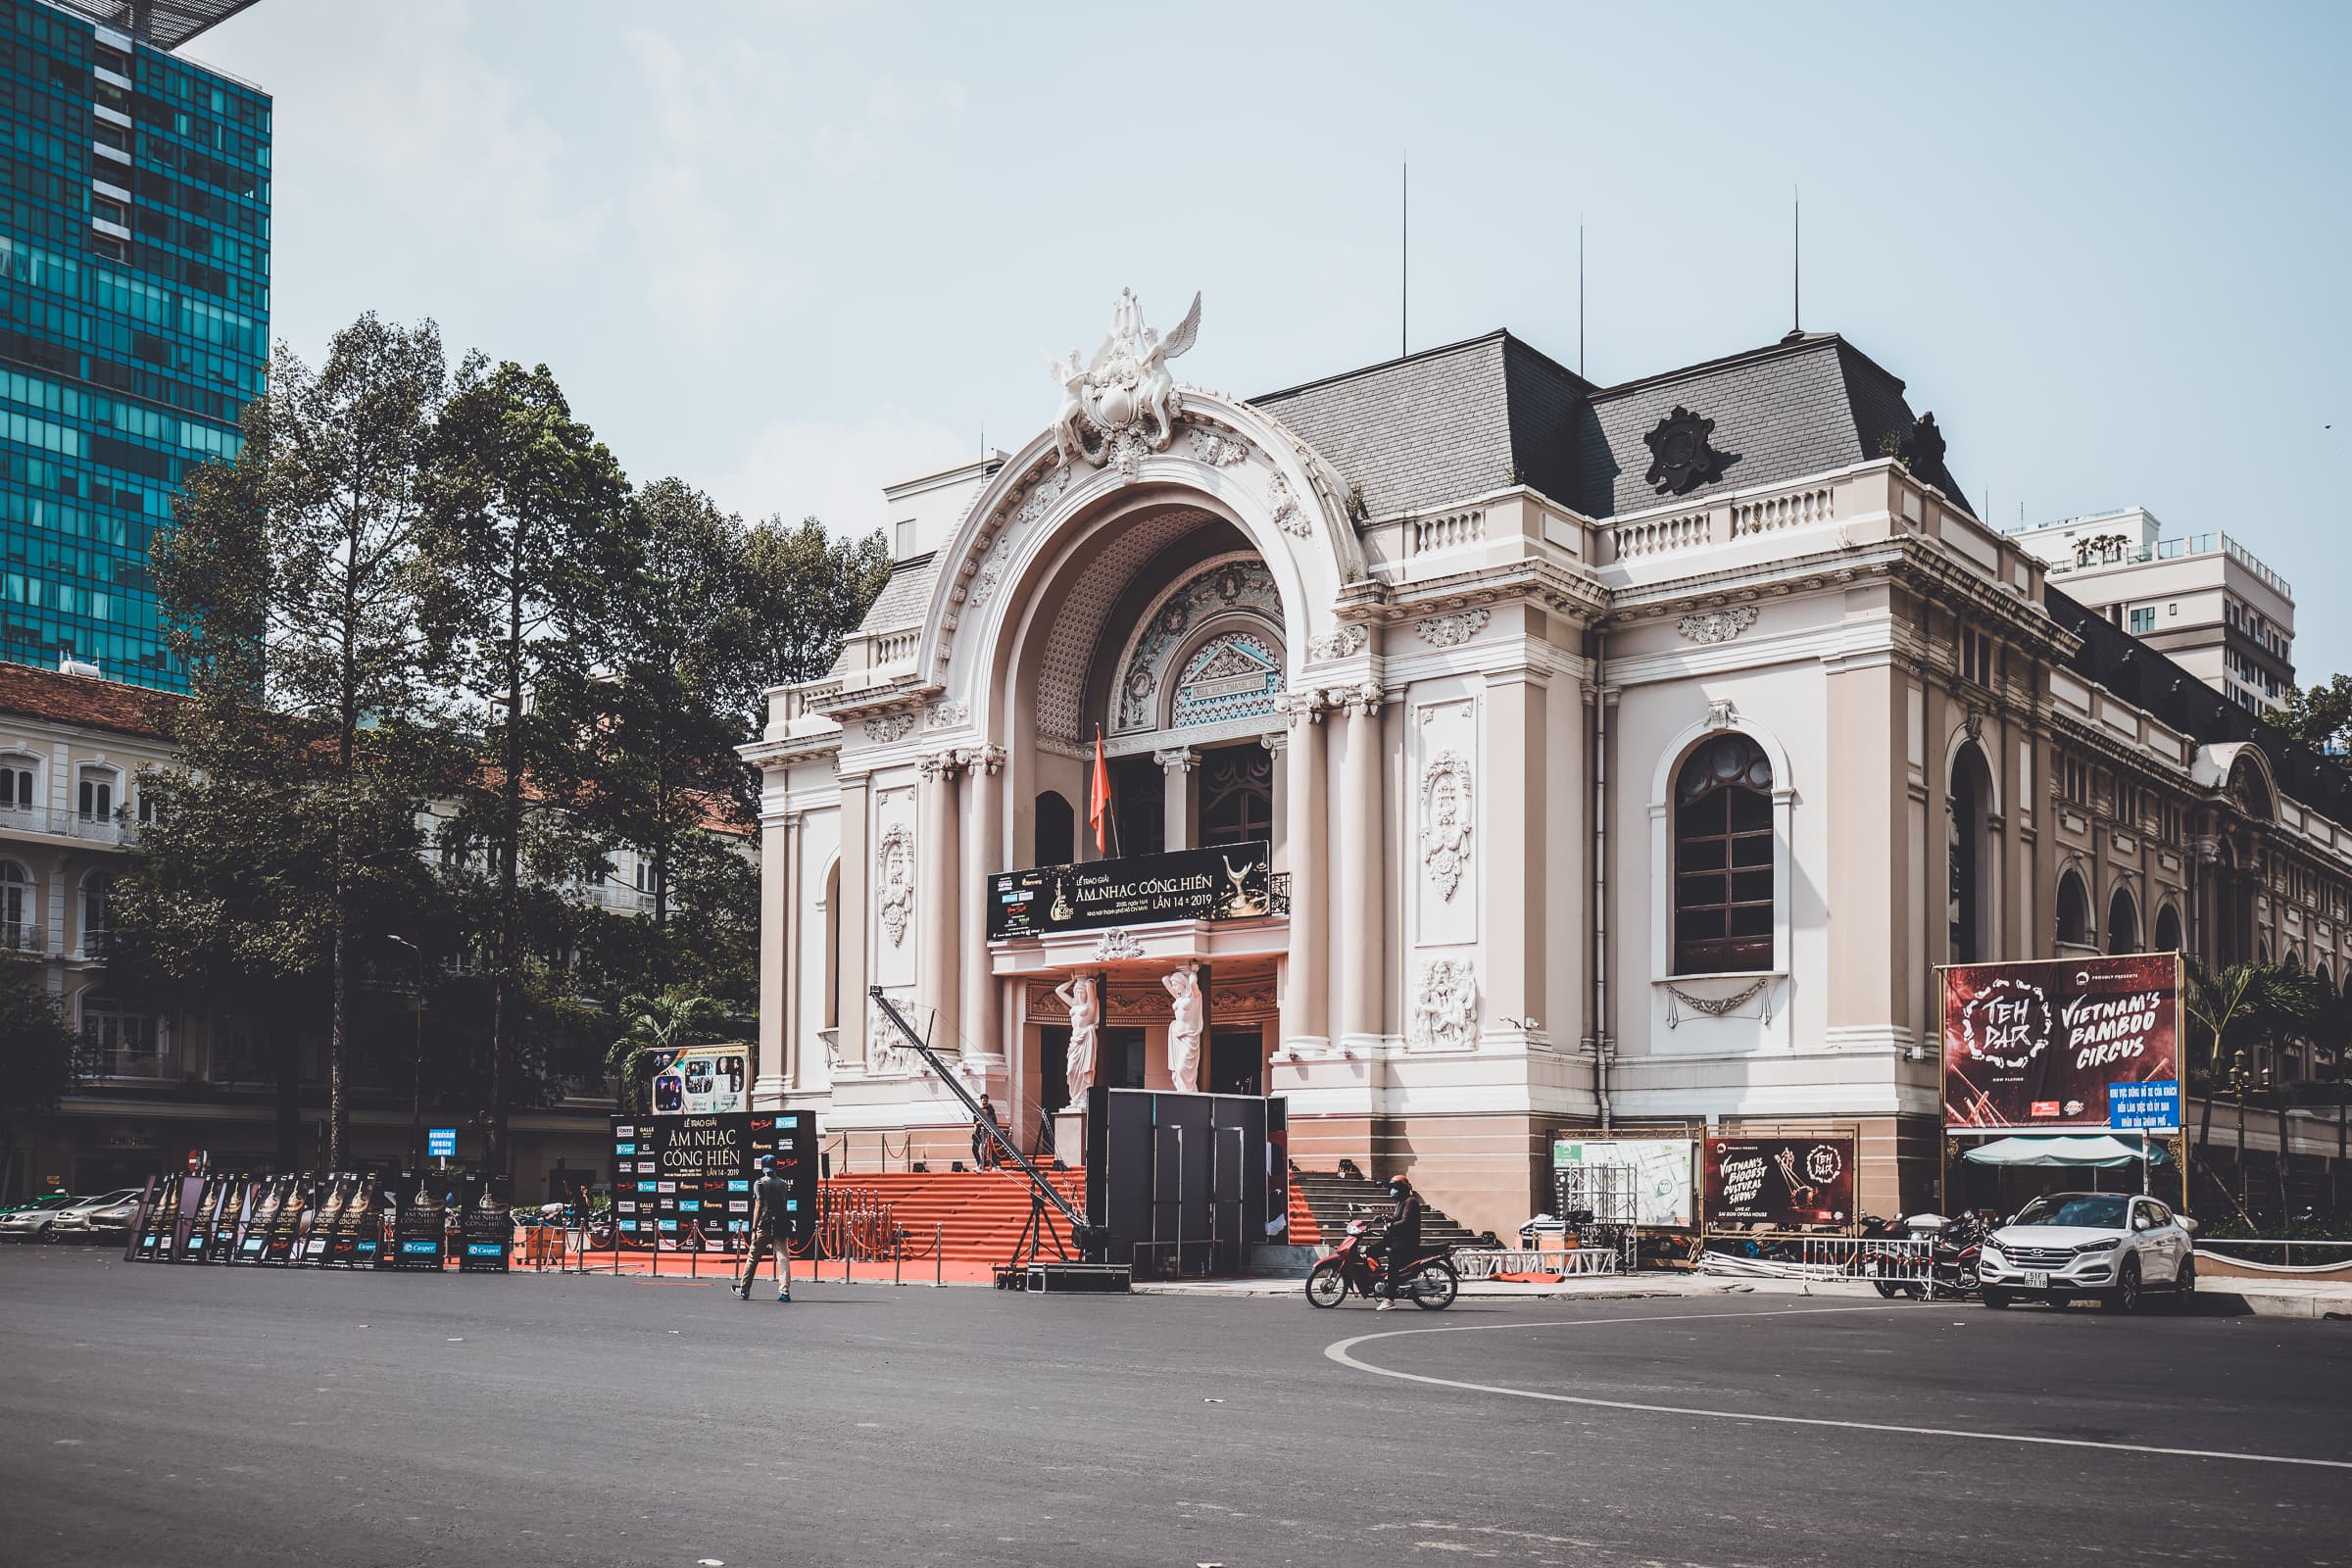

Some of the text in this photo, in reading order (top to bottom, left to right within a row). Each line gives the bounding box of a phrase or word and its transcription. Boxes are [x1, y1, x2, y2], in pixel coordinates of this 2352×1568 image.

[1099, 883, 1137, 899] NHẠC
[1139, 878, 1176, 894] CỐNG
[1180, 873, 1212, 891] HIẾN
[1152, 894, 1212, 909] LẦN 14 2019
[1982, 996, 2030, 1025] TEH
[2061, 992, 2161, 1029] VIETNAM'S
[1984, 1024, 2031, 1050] DAR
[2069, 1011, 2156, 1050] BAMBOO
[2076, 1035, 2144, 1070] CIRCUS
[668, 1129, 690, 1146] ÂM
[695, 1129, 736, 1147] NHẠC
[662, 1147, 740, 1166] CỐNG HIẾN
[1720, 1154, 1762, 1178] VIETNAM'S
[1813, 1152, 1833, 1164] TEH
[1723, 1179, 1762, 1196] CULTURAL
[1729, 1166, 1767, 1185] BIGGEST
